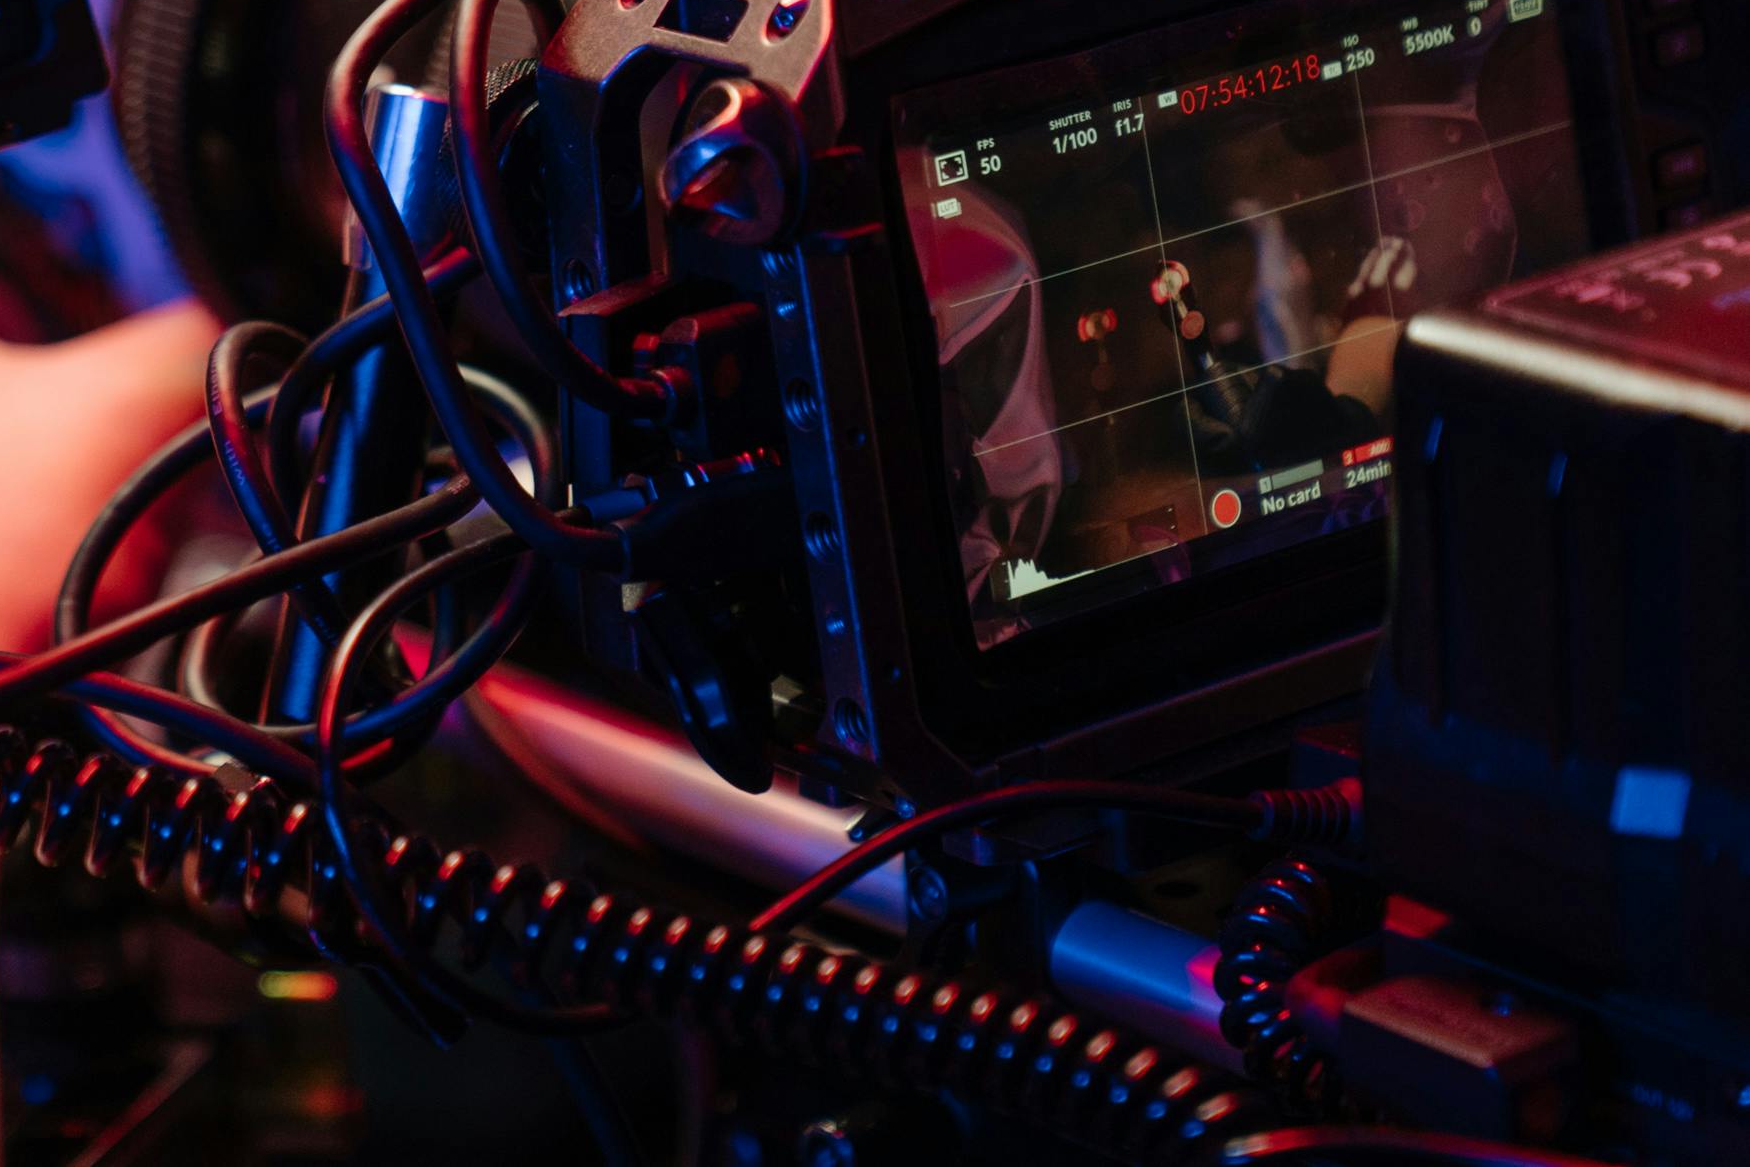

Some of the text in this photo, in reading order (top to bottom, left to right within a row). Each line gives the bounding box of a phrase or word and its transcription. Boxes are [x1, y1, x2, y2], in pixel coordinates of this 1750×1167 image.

[1467, 15, 1482, 37] 0
[1403, 24, 1455, 56] 5500K
[1346, 47, 1375, 72] 250
[1180, 54, 1320, 115] 07:54:12:18
[1113, 99, 1132, 113] IRIS
[1049, 110, 1092, 130] SHUTTER
[1115, 113, 1145, 137] f1.7
[976, 137, 995, 152] FPS
[1052, 127, 1098, 154] 1/100
[980, 155, 1001, 175] 50
[1346, 459, 1392, 489] 24min
[1261, 480, 1322, 515] No card
